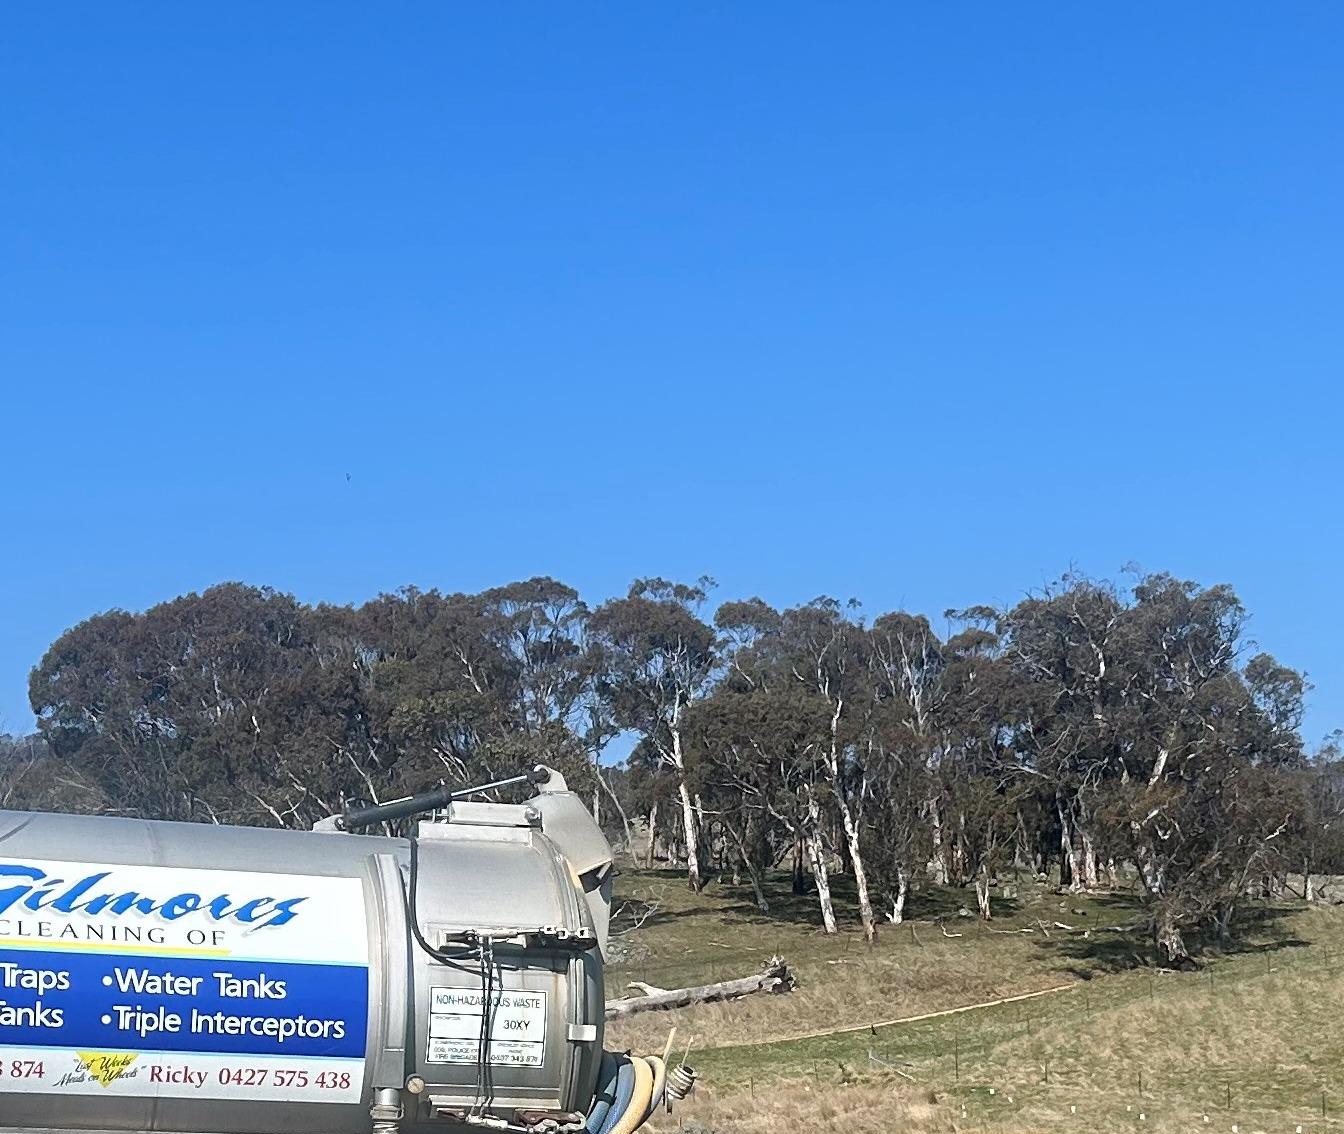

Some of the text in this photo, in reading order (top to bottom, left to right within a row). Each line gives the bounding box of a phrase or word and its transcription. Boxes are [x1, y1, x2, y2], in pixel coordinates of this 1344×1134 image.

[186, 930, 226, 946] OF
[114, 968, 287, 999] Water Tanks
[513, 998, 541, 1009] WASTE
[113, 1005, 346, 1042] Triple Interceptors
[503, 1020, 530, 1030] 30XY
[10, 1060, 45, 1078] 874
[149, 1065, 351, 1089] Ricky 0427 575 438
